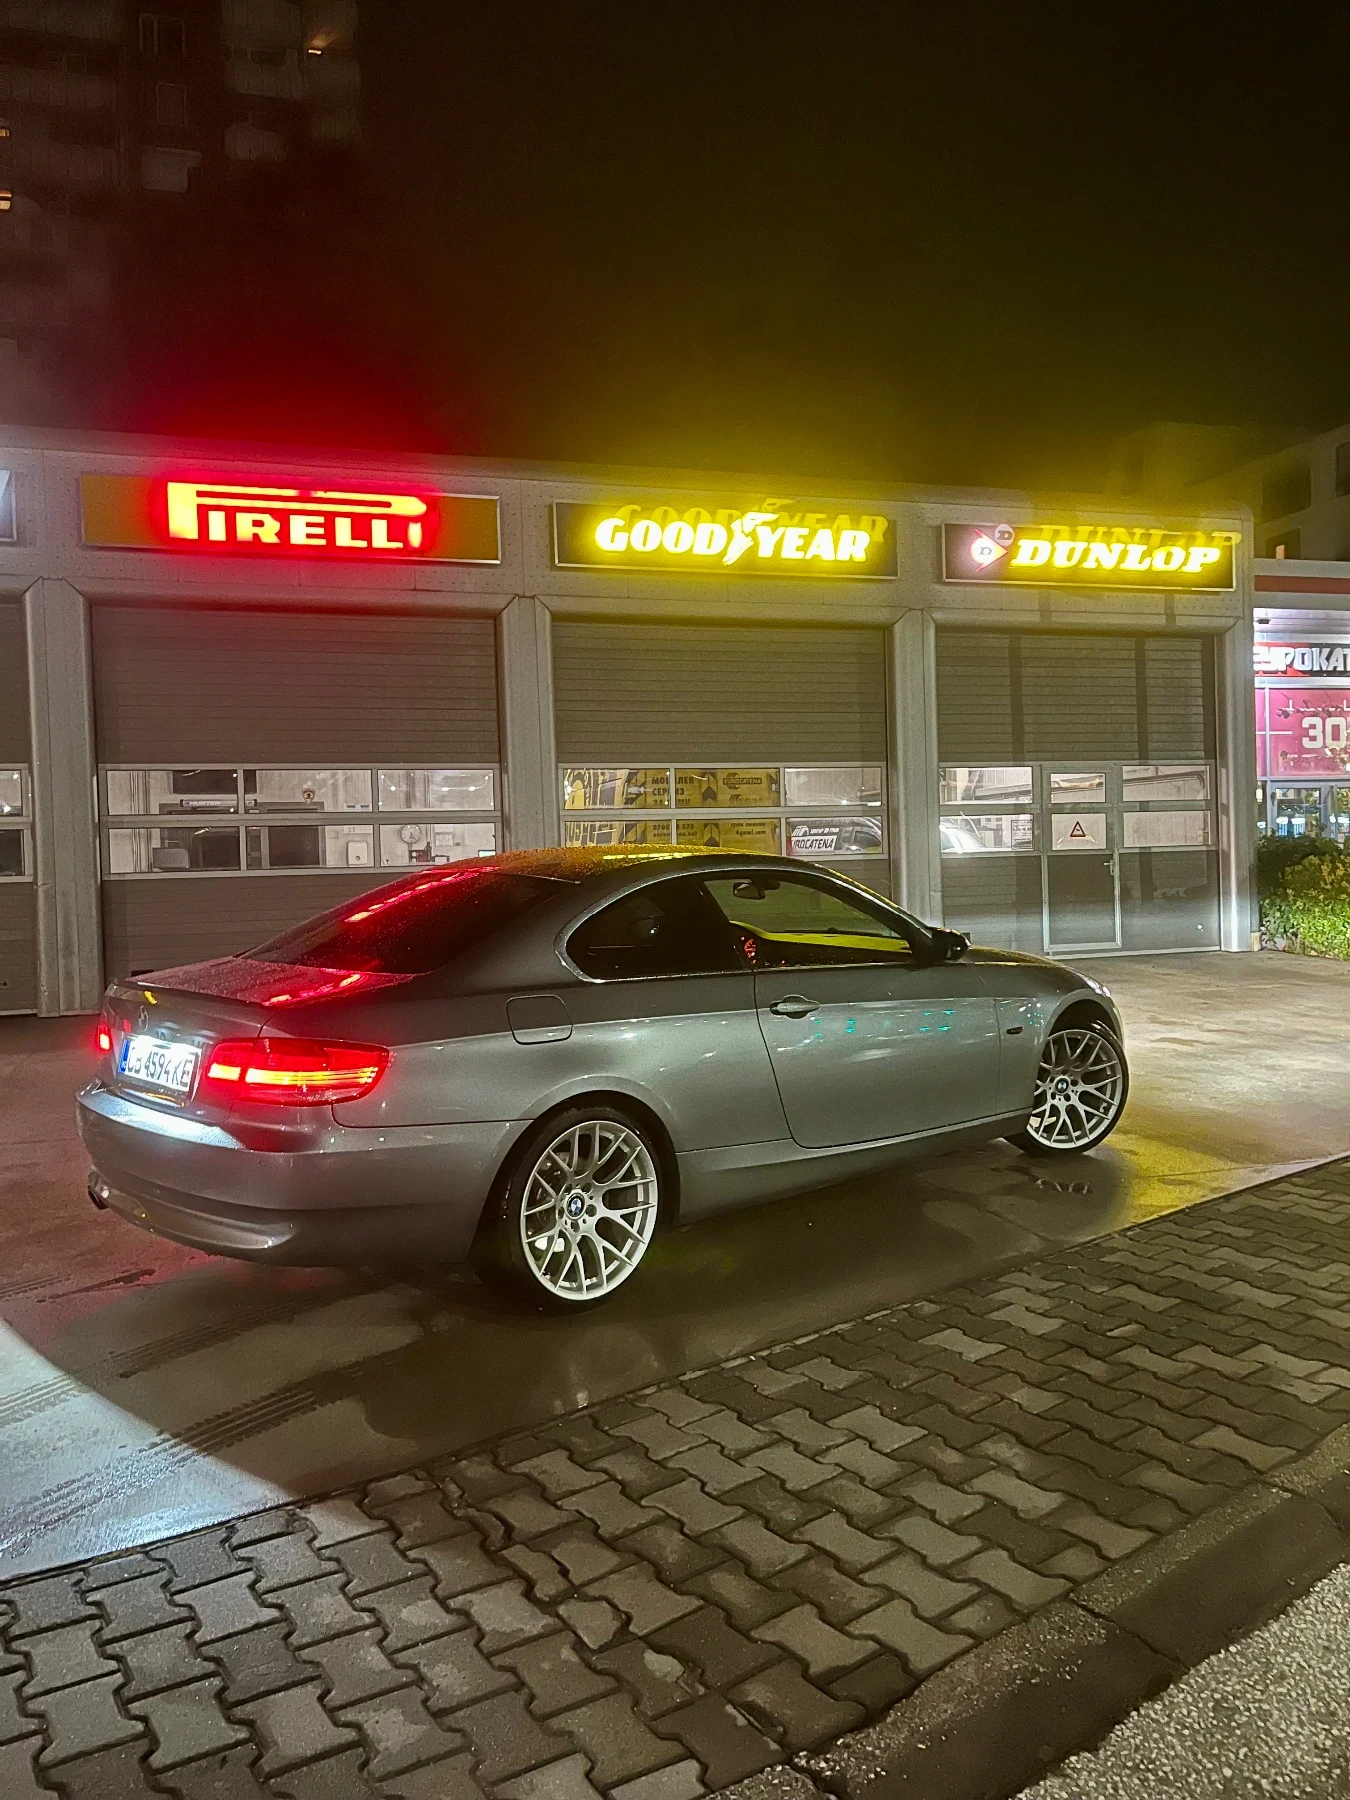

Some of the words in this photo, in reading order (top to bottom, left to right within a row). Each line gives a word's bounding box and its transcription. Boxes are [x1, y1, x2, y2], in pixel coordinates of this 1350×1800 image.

[167, 482, 427, 549] PIRELLI
[1008, 539, 1221, 574] DUNLOP
[651, 776, 695, 785] МОЛЕН
[652, 787, 685, 796] СЕРЗ
